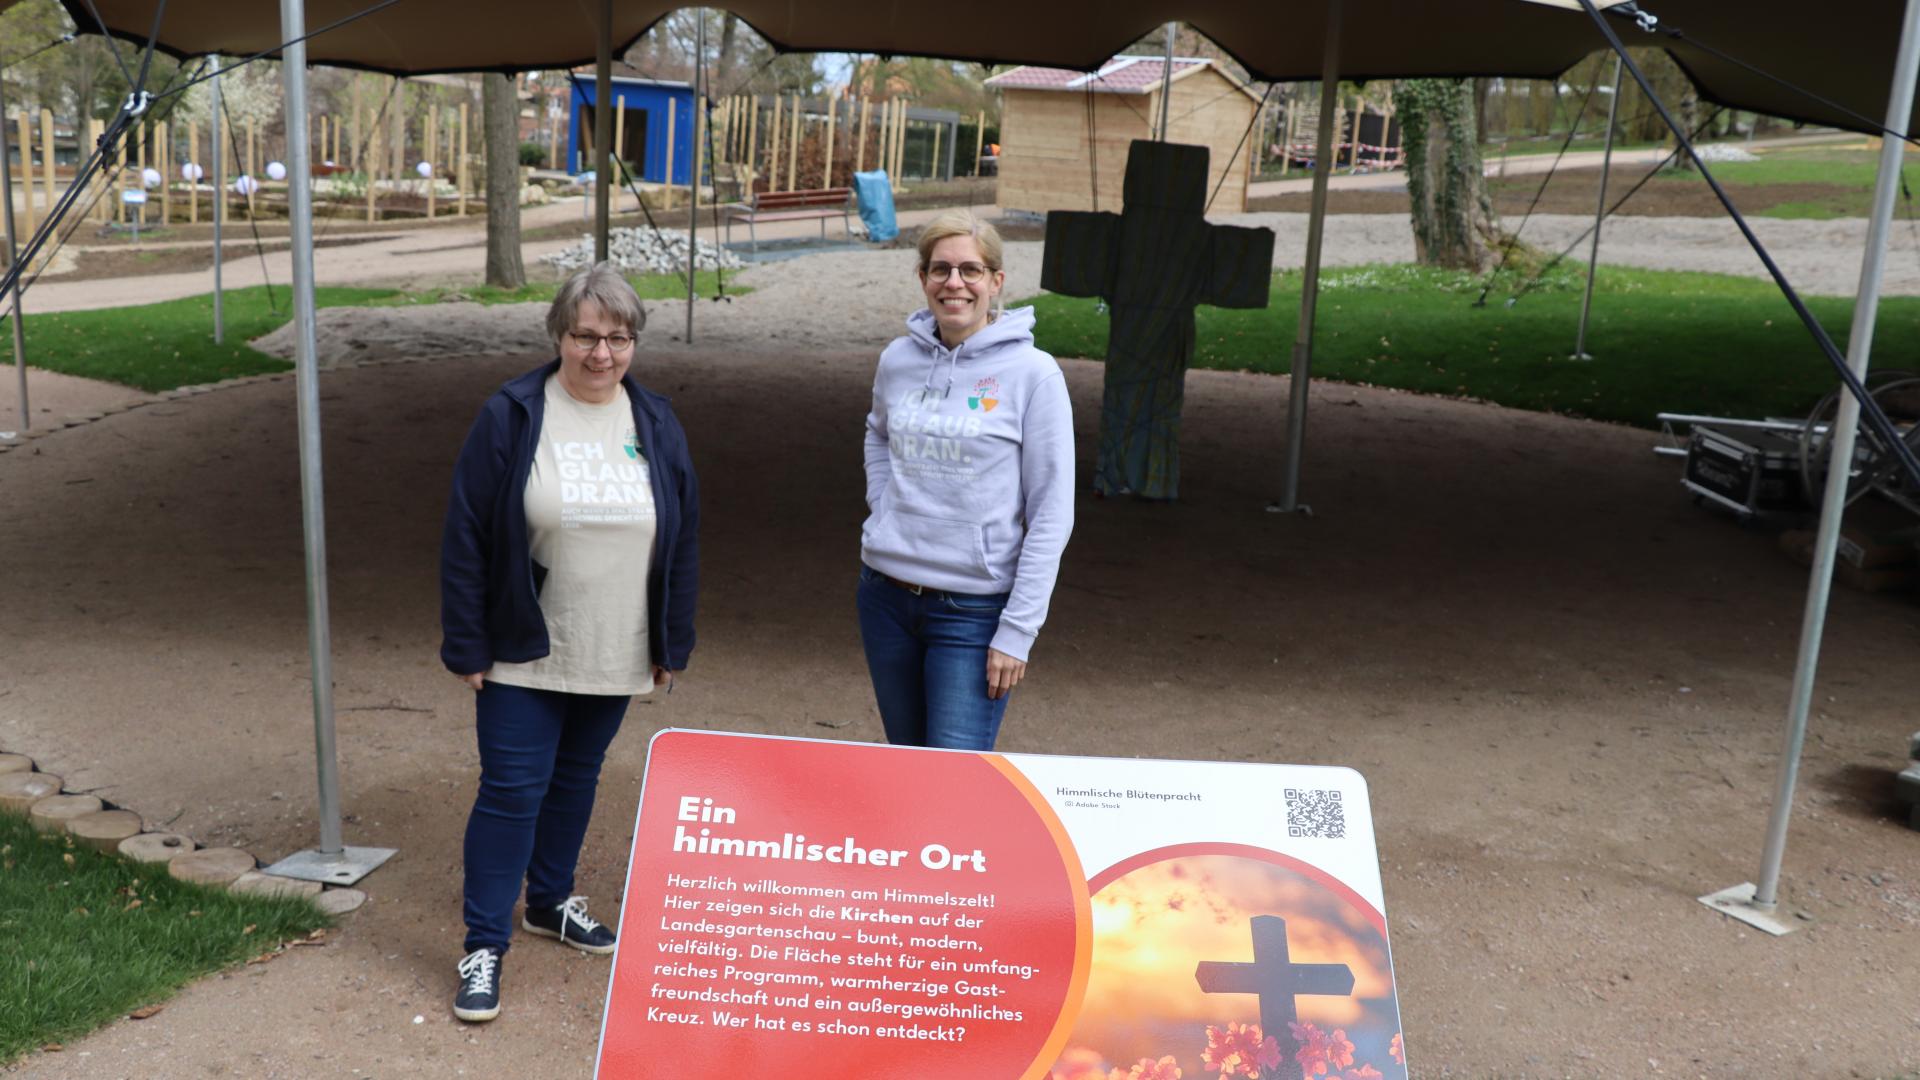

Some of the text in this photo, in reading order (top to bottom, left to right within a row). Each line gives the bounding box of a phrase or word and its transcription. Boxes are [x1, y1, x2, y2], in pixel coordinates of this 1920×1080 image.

[890, 410, 981, 438] GLAUB
[553, 442, 605, 460] ICH
[889, 432, 972, 463] DRAN.
[678, 796, 735, 824] Ein
[1056, 787, 1202, 802] Himmlische Blütenpracht
[674, 826, 986, 872] himmlischer Ort
[668, 874, 994, 907] Herzlich willkommen am Himmelszelt!
[665, 895, 983, 928] Hier zeigen sich die Kirchen auf der
[661, 916, 836, 942] Landesgartenschau
[858, 929, 902, 947] bunt,
[910, 935, 982, 952] modern,
[658, 940, 1039, 979] vielfältig. Die Fläche steht für ein umfang-
[654, 962, 1005, 996] reiches Programm, warmherzige Gast-
[652, 983, 1022, 1021] freundschaft und ein außergewöhnliches
[648, 1007, 965, 1041] Kreuz. Wer hat es schon entdeckt?
